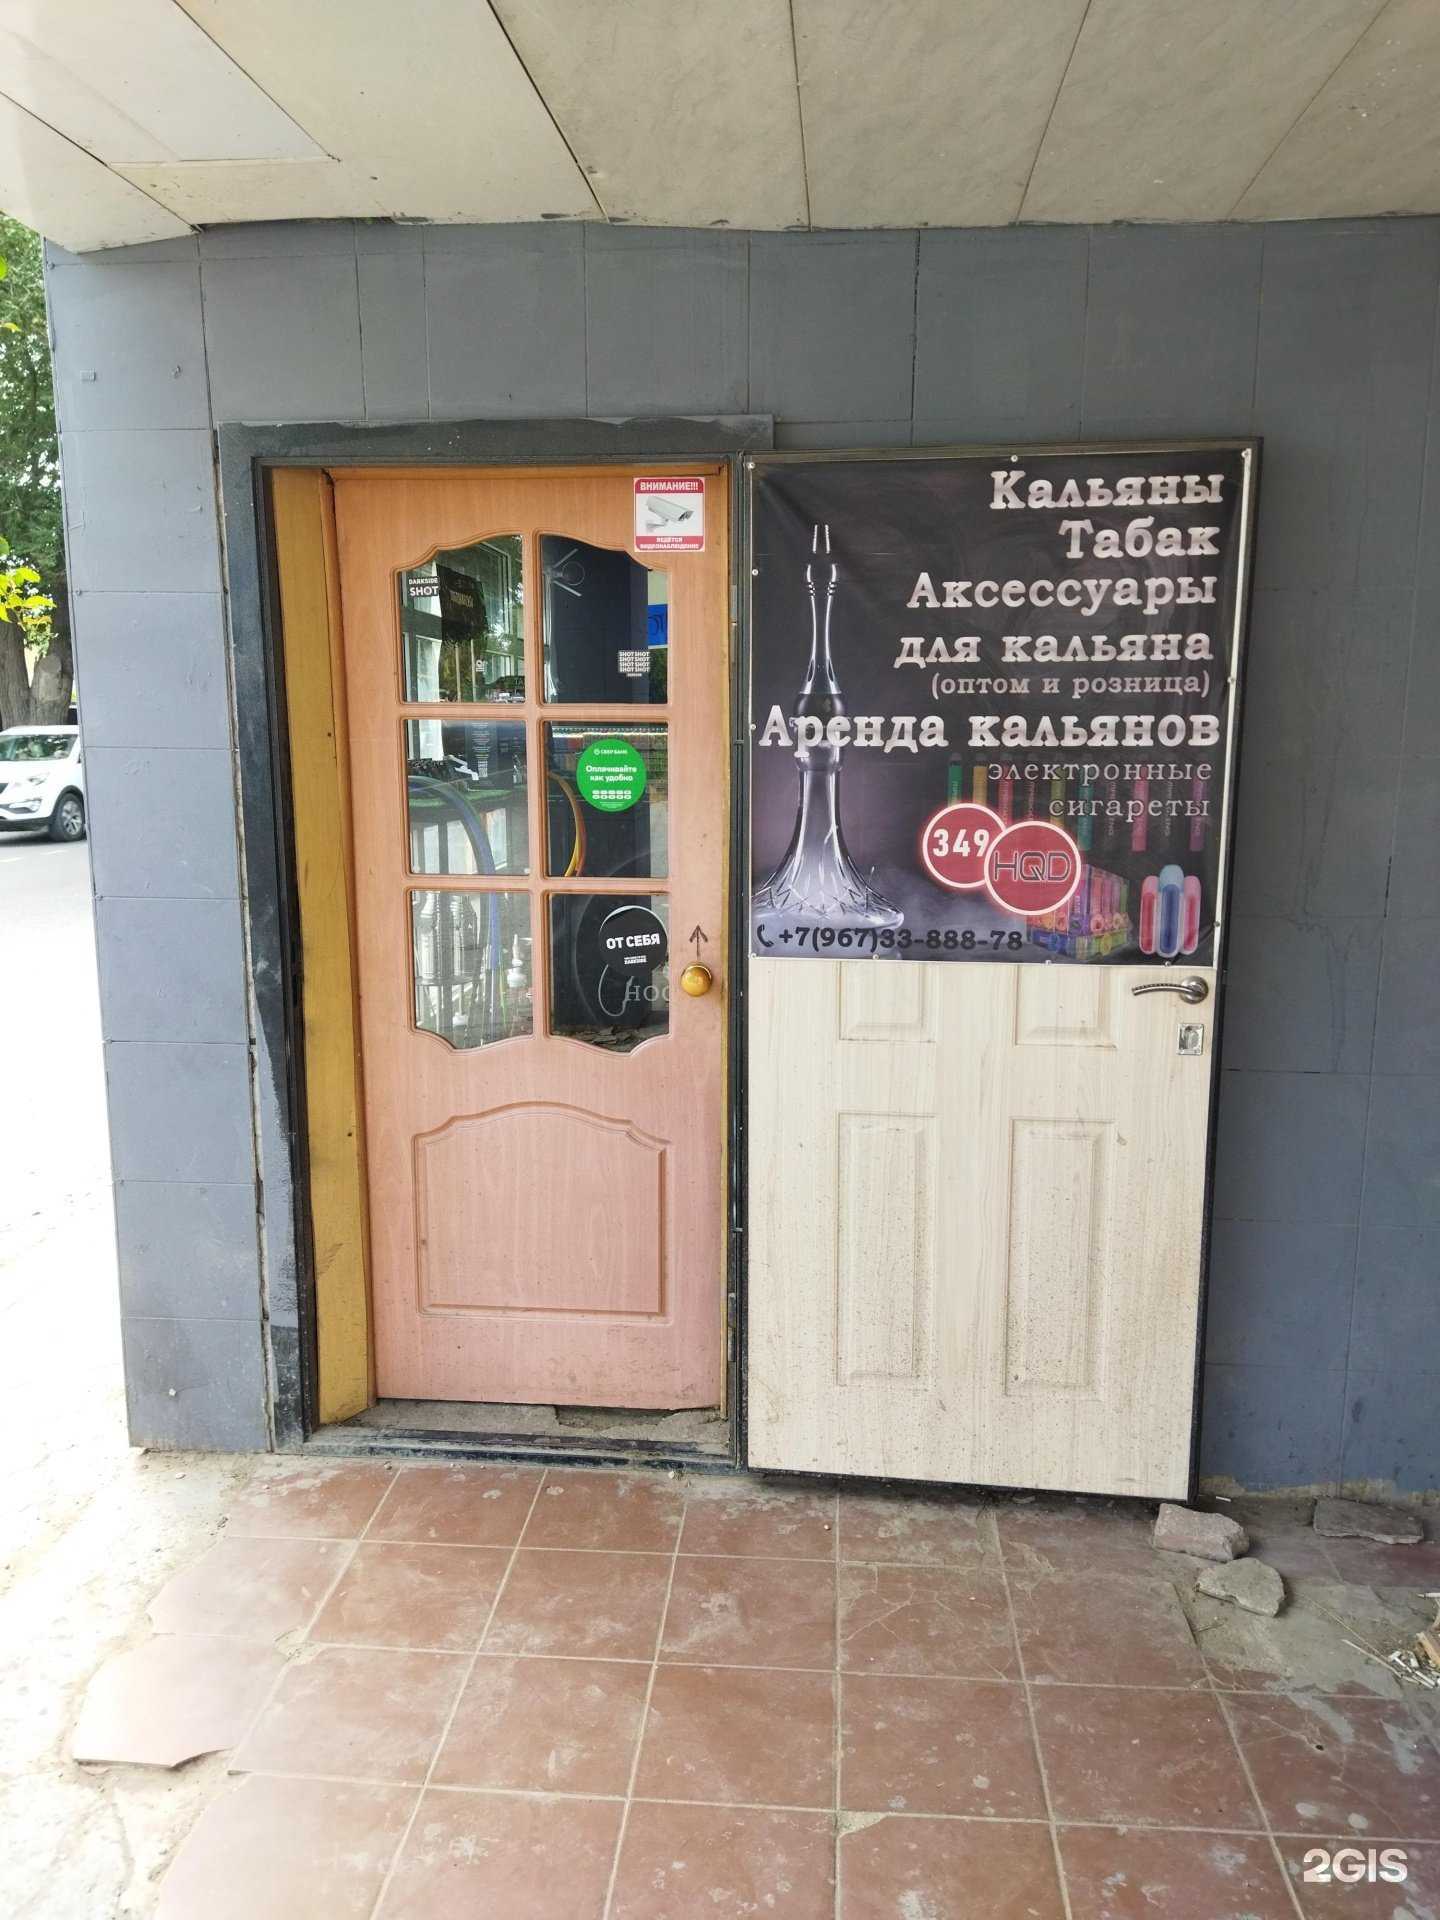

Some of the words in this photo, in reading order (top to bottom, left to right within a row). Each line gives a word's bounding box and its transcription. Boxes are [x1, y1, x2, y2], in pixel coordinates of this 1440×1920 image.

[640, 481, 699, 491] ВНИМАНИЕ!!!
[989, 470, 1225, 510] Кальяны
[1058, 515, 1221, 559] Табак
[408, 577, 439, 585] DARKSIDE
[409, 585, 439, 597] SHOT
[906, 571, 1218, 616] Аксессуары
[893, 635, 982, 669] для
[1001, 631, 1214, 664] кальяна
[931, 673, 1030, 696] (оптом
[1041, 676, 1061, 694] и
[1071, 671, 1211, 698] розница)
[758, 704, 950, 758] Аренда
[967, 713, 1221, 748] кальянов
[987, 761, 1212, 787] электронные
[1048, 798, 1210, 823] сигареты
[931, 828, 990, 858] 349
[993, 850, 1072, 883] HQD
[606, 937, 624, 949] ОТ
[626, 933, 661, 947] СЕБЯ
[779, 926, 1024, 953] +7(967)33-888-78
